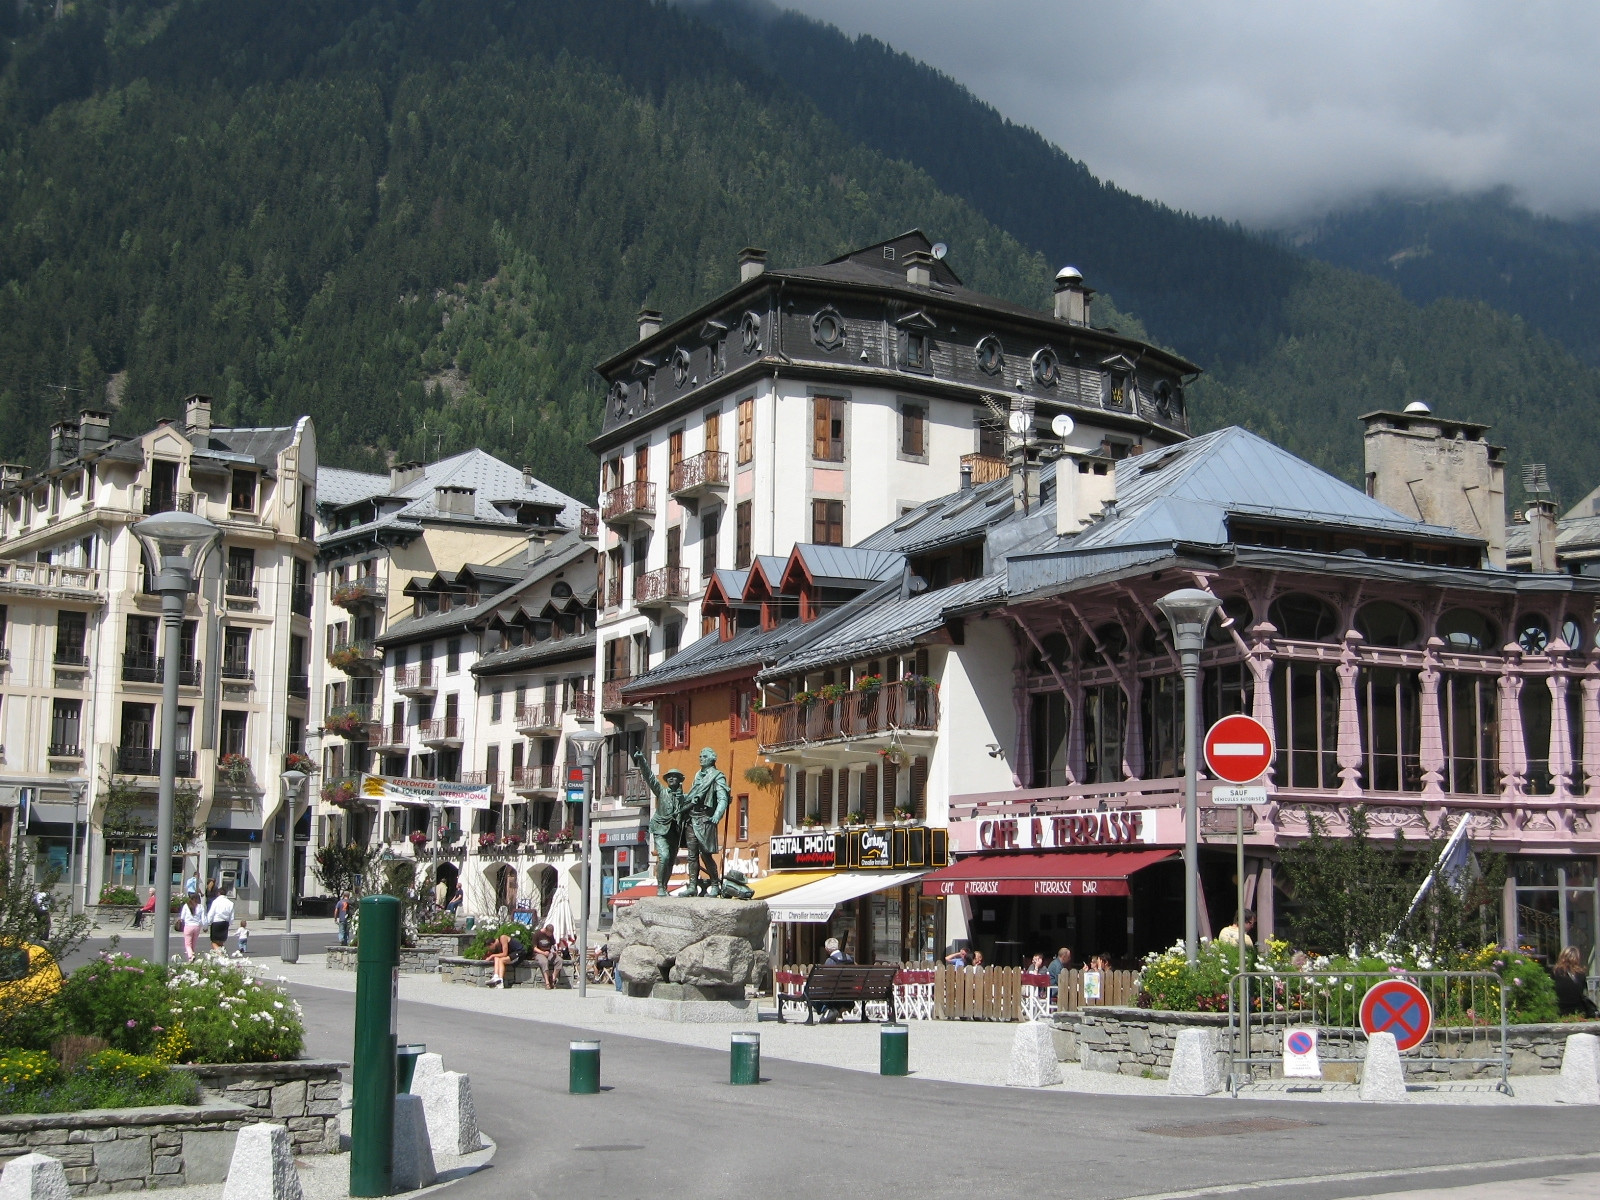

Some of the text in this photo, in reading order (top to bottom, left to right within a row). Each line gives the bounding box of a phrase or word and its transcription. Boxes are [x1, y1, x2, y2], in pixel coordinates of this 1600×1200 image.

[438, 791, 487, 801] INTERNATIONAL
[1049, 811, 1144, 847] TERRASSE
[771, 835, 835, 855] DIGITAL PHOTO
[861, 831, 884, 850] Century
[880, 841, 889, 858] 21
[969, 881, 999, 894] TERRASSE
[1039, 881, 1072, 894] TERRASSE
[1081, 881, 1098, 893] BAR
